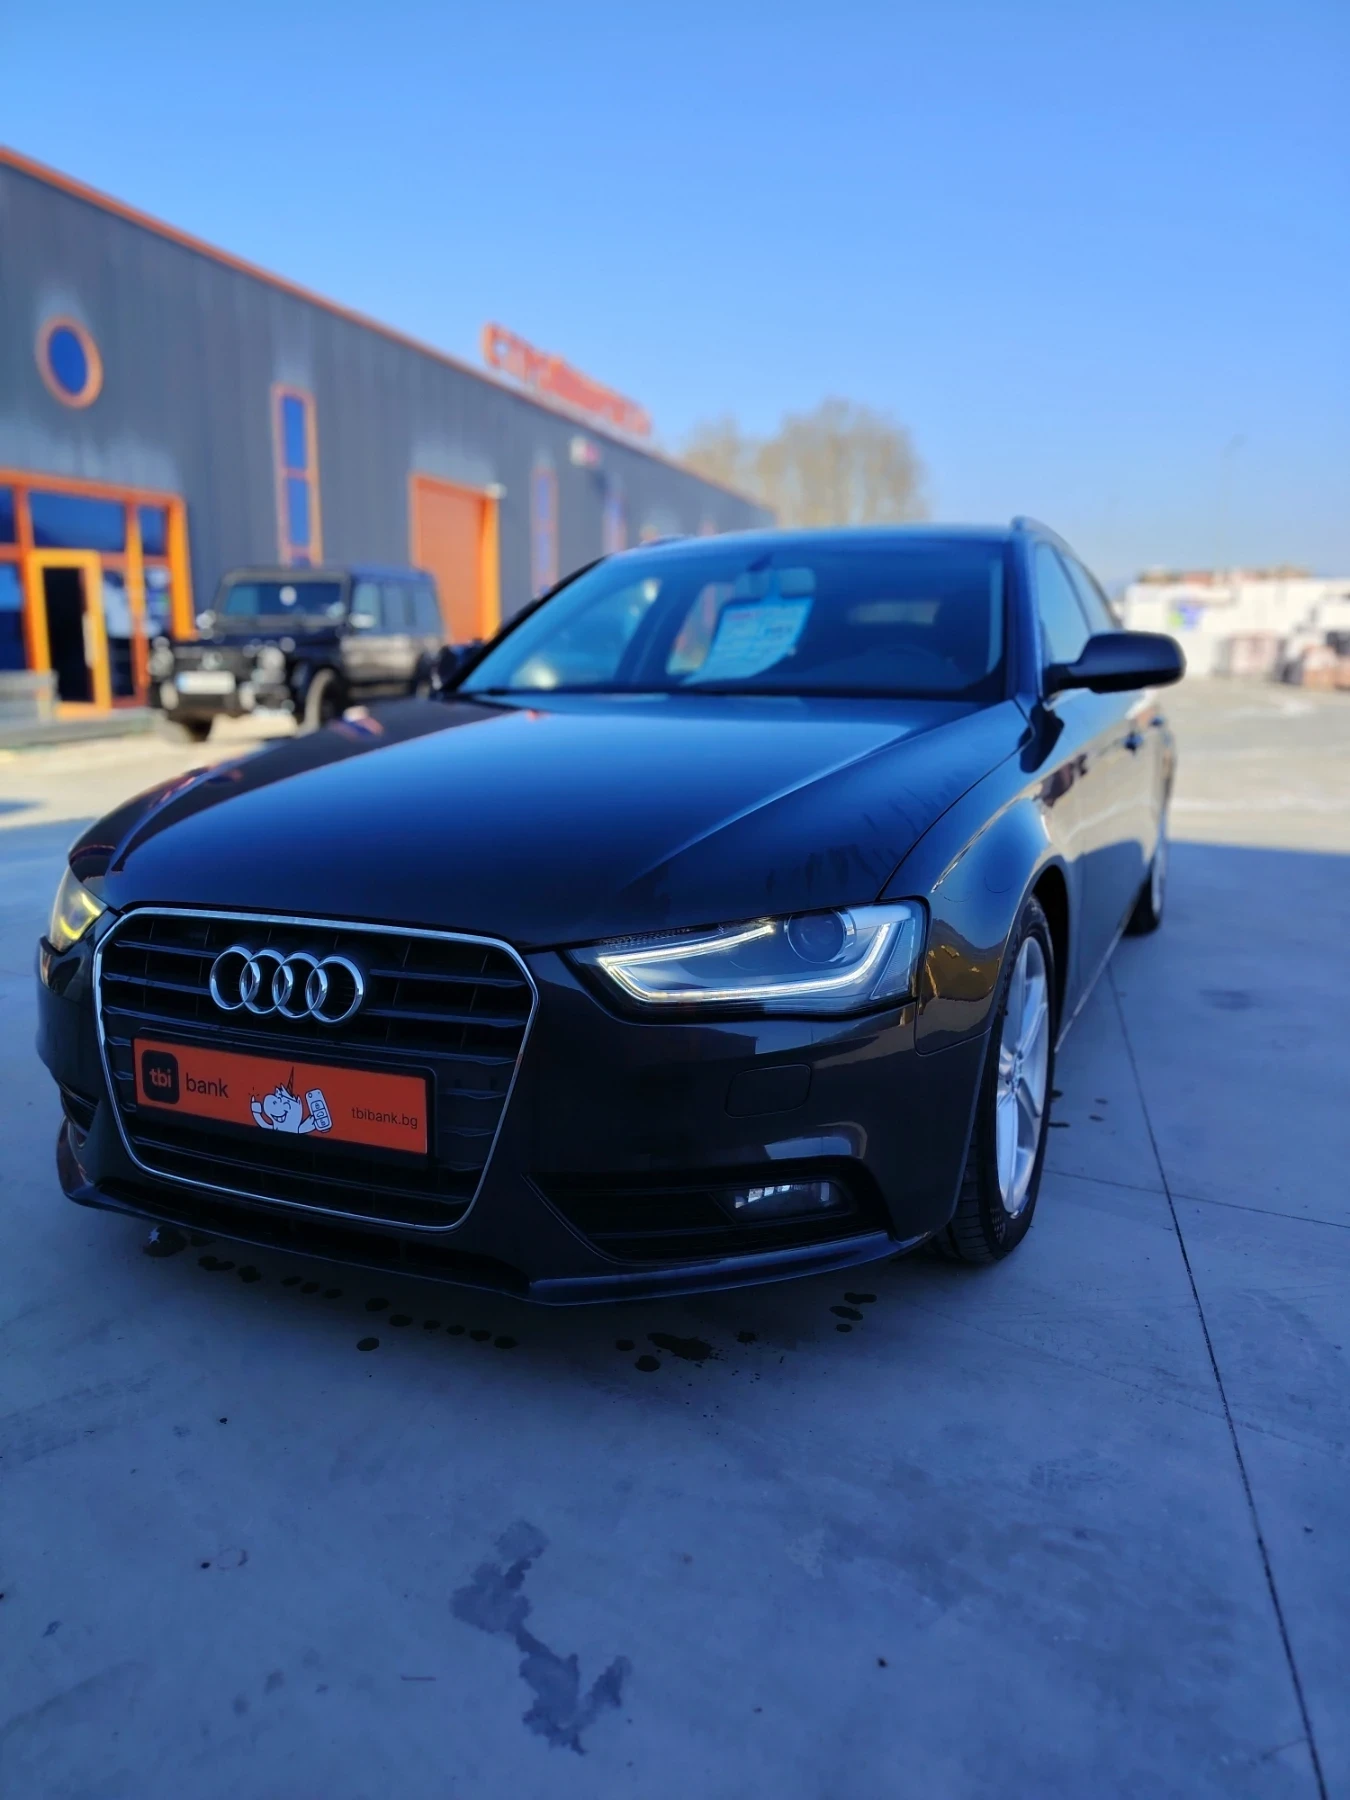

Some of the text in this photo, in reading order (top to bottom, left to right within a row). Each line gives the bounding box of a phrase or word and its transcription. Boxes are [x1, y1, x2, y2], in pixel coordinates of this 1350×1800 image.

[149, 1068, 229, 1099] tbi bank
[351, 1107, 418, 1130] tbibank.bg
